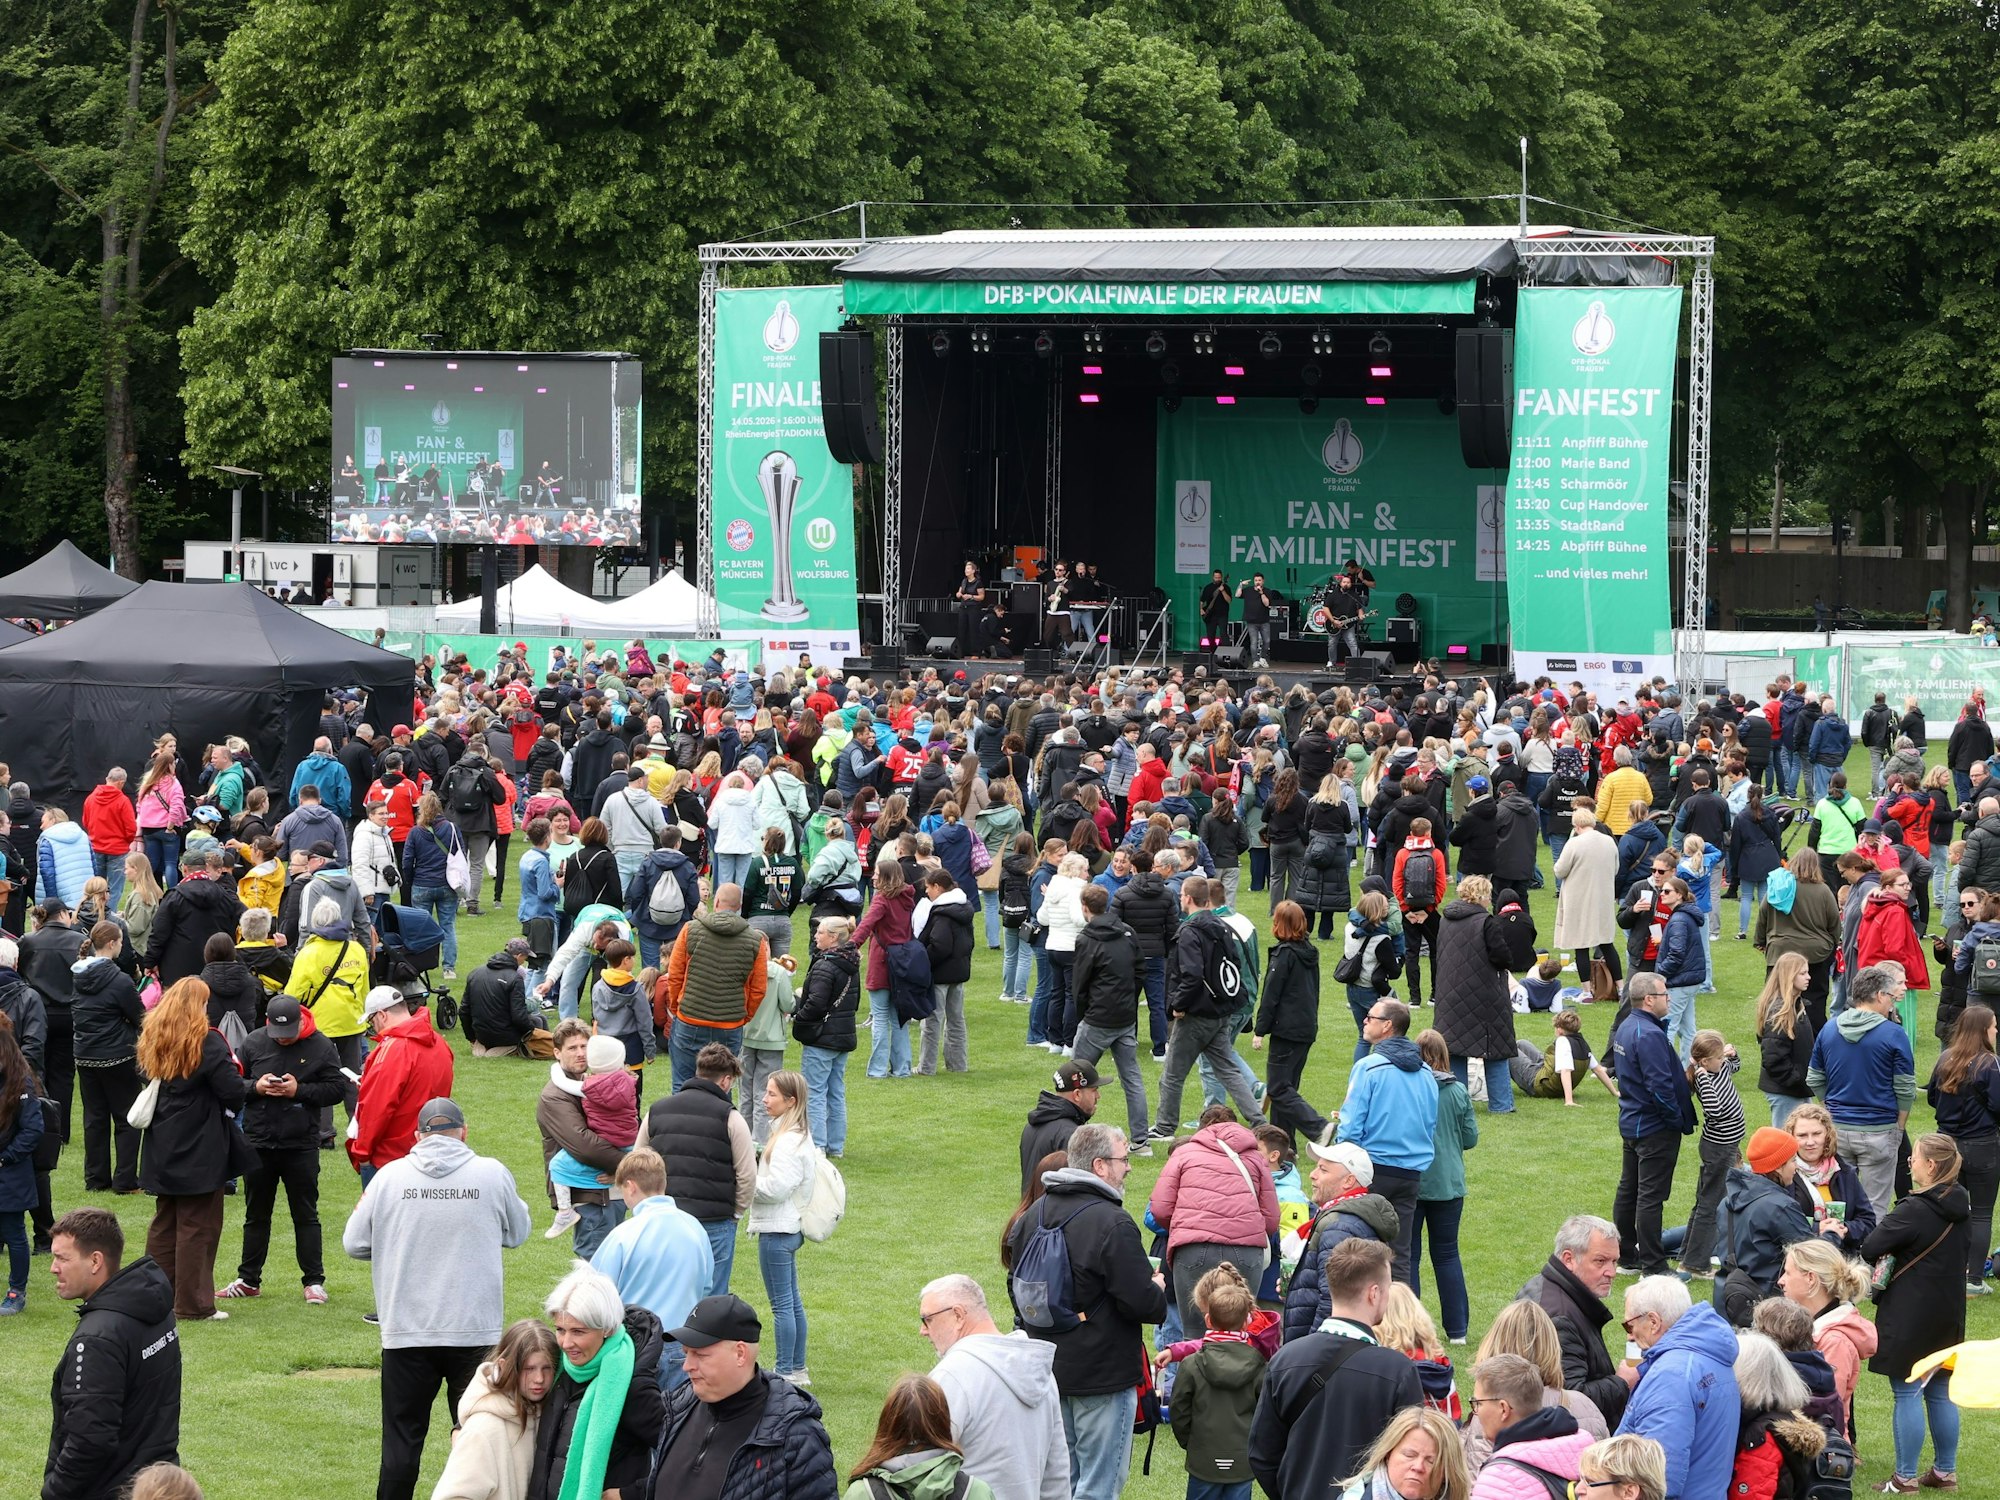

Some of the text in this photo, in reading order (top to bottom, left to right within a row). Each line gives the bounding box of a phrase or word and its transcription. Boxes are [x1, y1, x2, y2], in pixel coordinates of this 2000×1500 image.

[984, 285, 1322, 305] DFB-POKALFINALE DER FRAUEN
[1518, 388, 1661, 416] FANFEST
[732, 417, 776, 426] 14.05.2026
[783, 416, 806, 424] 16:00
[725, 430, 812, 440] RheinEnergieSTADION
[416, 436, 464, 449] FAN- &
[1516, 436, 1648, 450] 11:11 Anpfiff Bühne
[1516, 457, 1630, 470] 12:00 Marie Band
[1515, 478, 1628, 490] 12:45 Scharmöör
[1515, 498, 1648, 512] 13:20 Cup Handover
[1288, 501, 1397, 530] FAN- &
[1516, 520, 1624, 532] 13:35 StadtRand
[1230, 536, 1456, 568] FAMILIENFEST
[1516, 540, 1647, 554] 14:25 Abpfiff Bühne
[404, 564, 416, 573] WC
[720, 560, 764, 568] FC BAYERN
[814, 560, 830, 568] VFL
[721, 570, 764, 578] MÜNCHEN
[796, 570, 850, 579] WOLFSBURG
[1546, 568, 1570, 578] und
[1573, 568, 1608, 580] vieles
[1612, 568, 1648, 580] mehr!
[1874, 680, 1998, 690] FAN- & FAMILIENFEST
[902, 758, 924, 778] 25
[760, 866, 796, 876] WLFSBURG
[402, 1188, 480, 1200] JSG WISSERLAND
